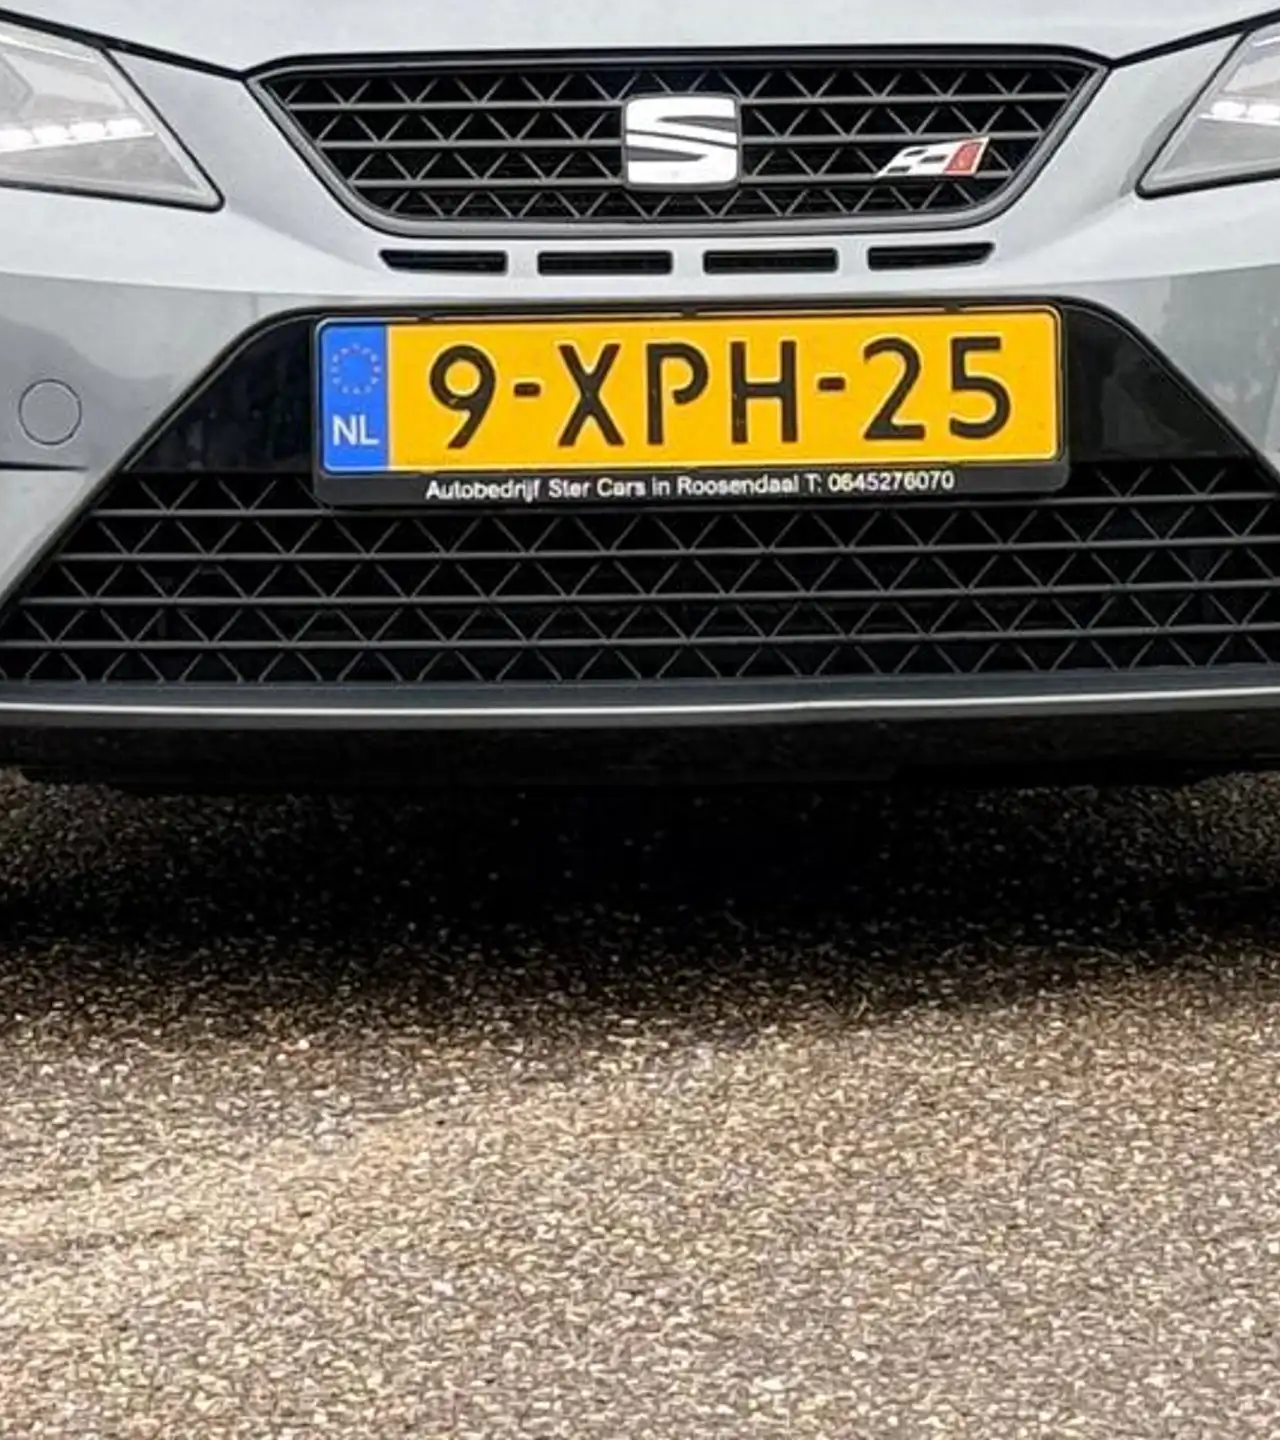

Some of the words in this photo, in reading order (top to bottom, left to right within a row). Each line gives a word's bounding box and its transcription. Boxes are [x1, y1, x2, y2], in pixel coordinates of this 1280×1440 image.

[429, 336, 1012, 448] 9-XPH-25
[333, 416, 379, 446] NL
[426, 478, 540, 502] Autobedrijf
[548, 478, 590, 498] Ster
[597, 477, 645, 497] Cars
[652, 475, 671, 495] in
[677, 475, 799, 496] Roosendaal
[827, 471, 955, 492] 0645276070
